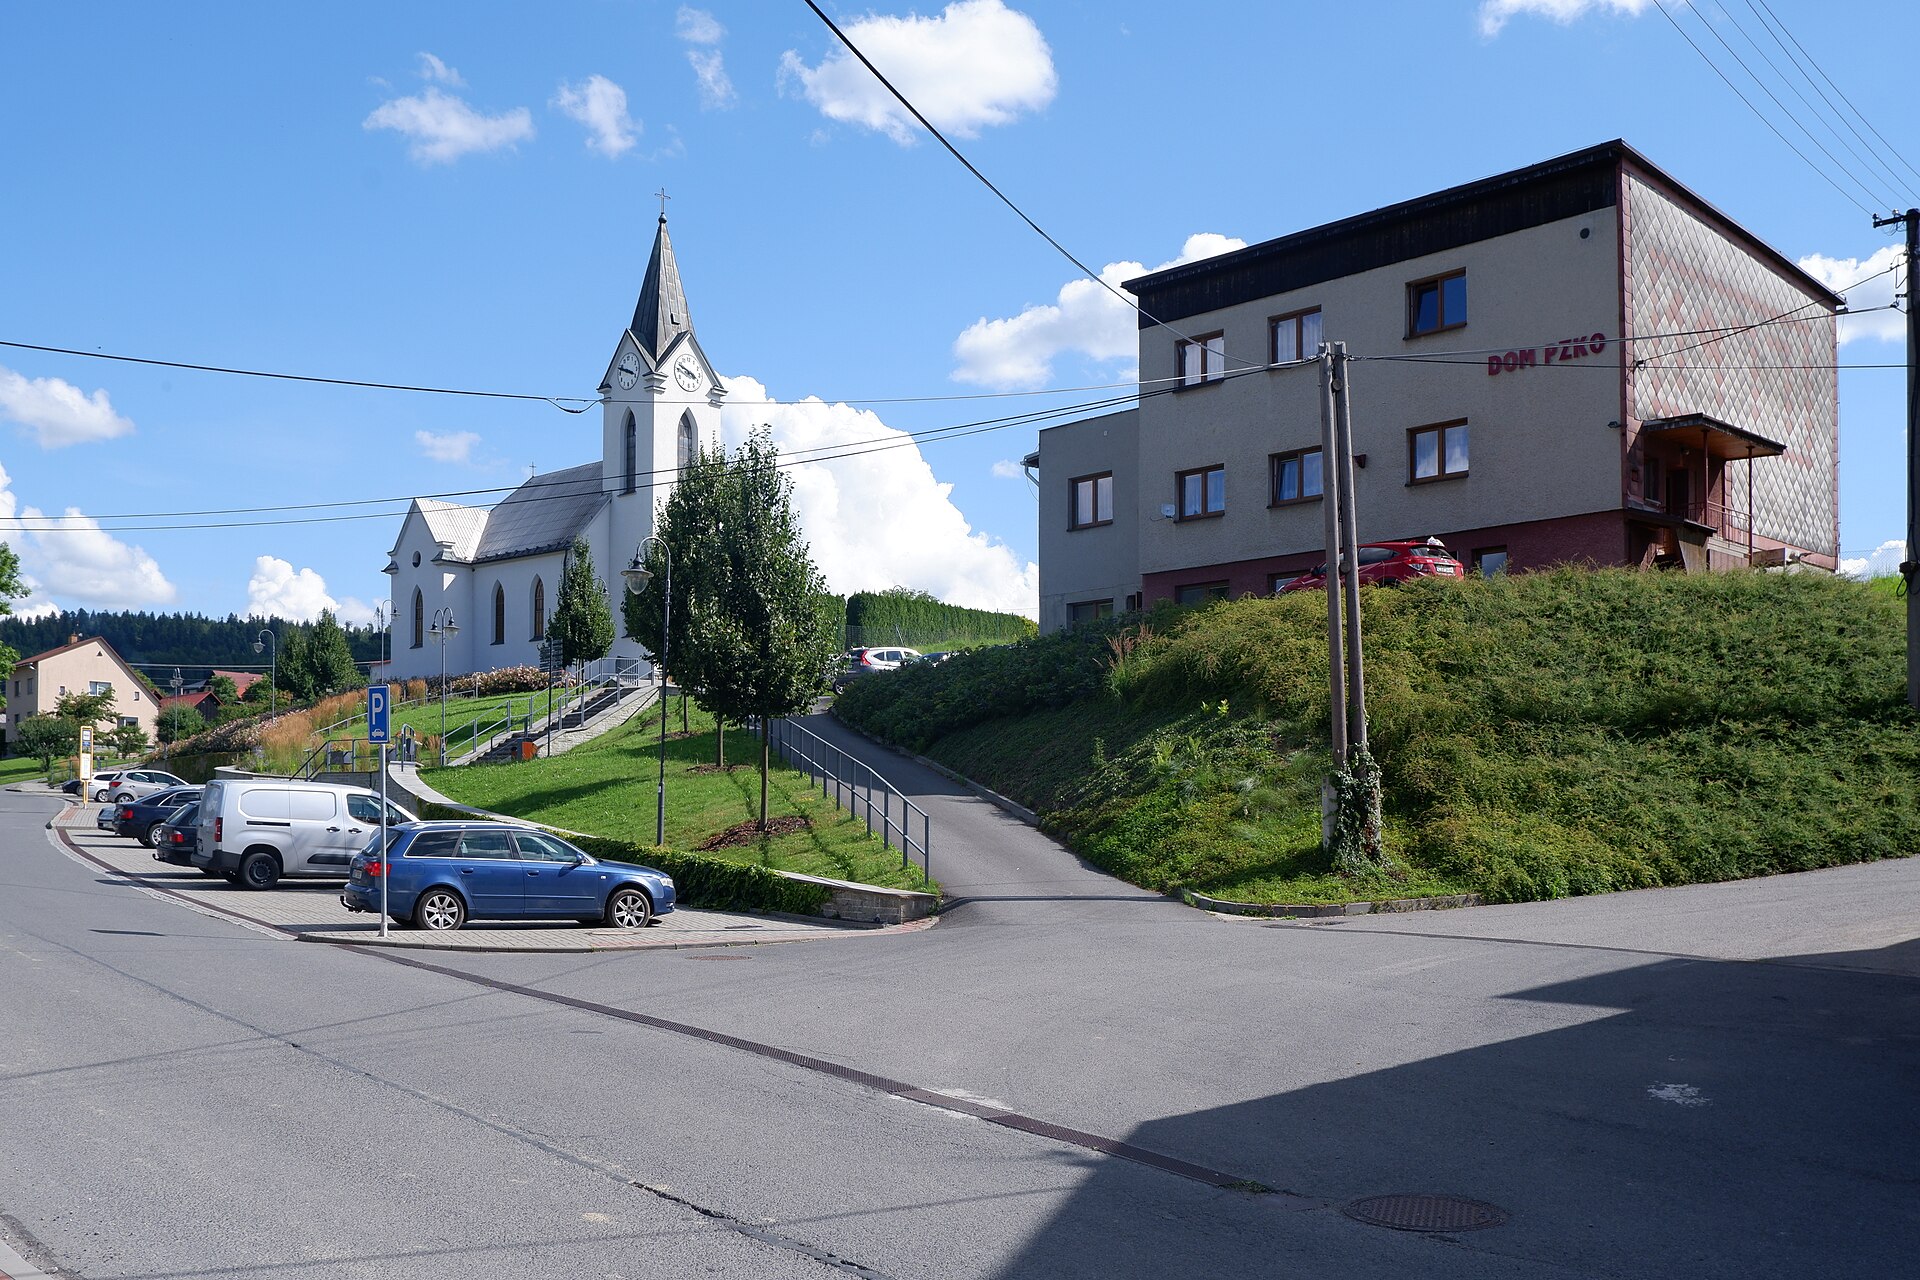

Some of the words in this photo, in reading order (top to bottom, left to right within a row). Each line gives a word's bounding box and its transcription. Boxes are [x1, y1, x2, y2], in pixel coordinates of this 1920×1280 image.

[1488, 349, 1536, 376] DOM
[1544, 332, 1606, 364] PZKO
[372, 693, 384, 725] P
